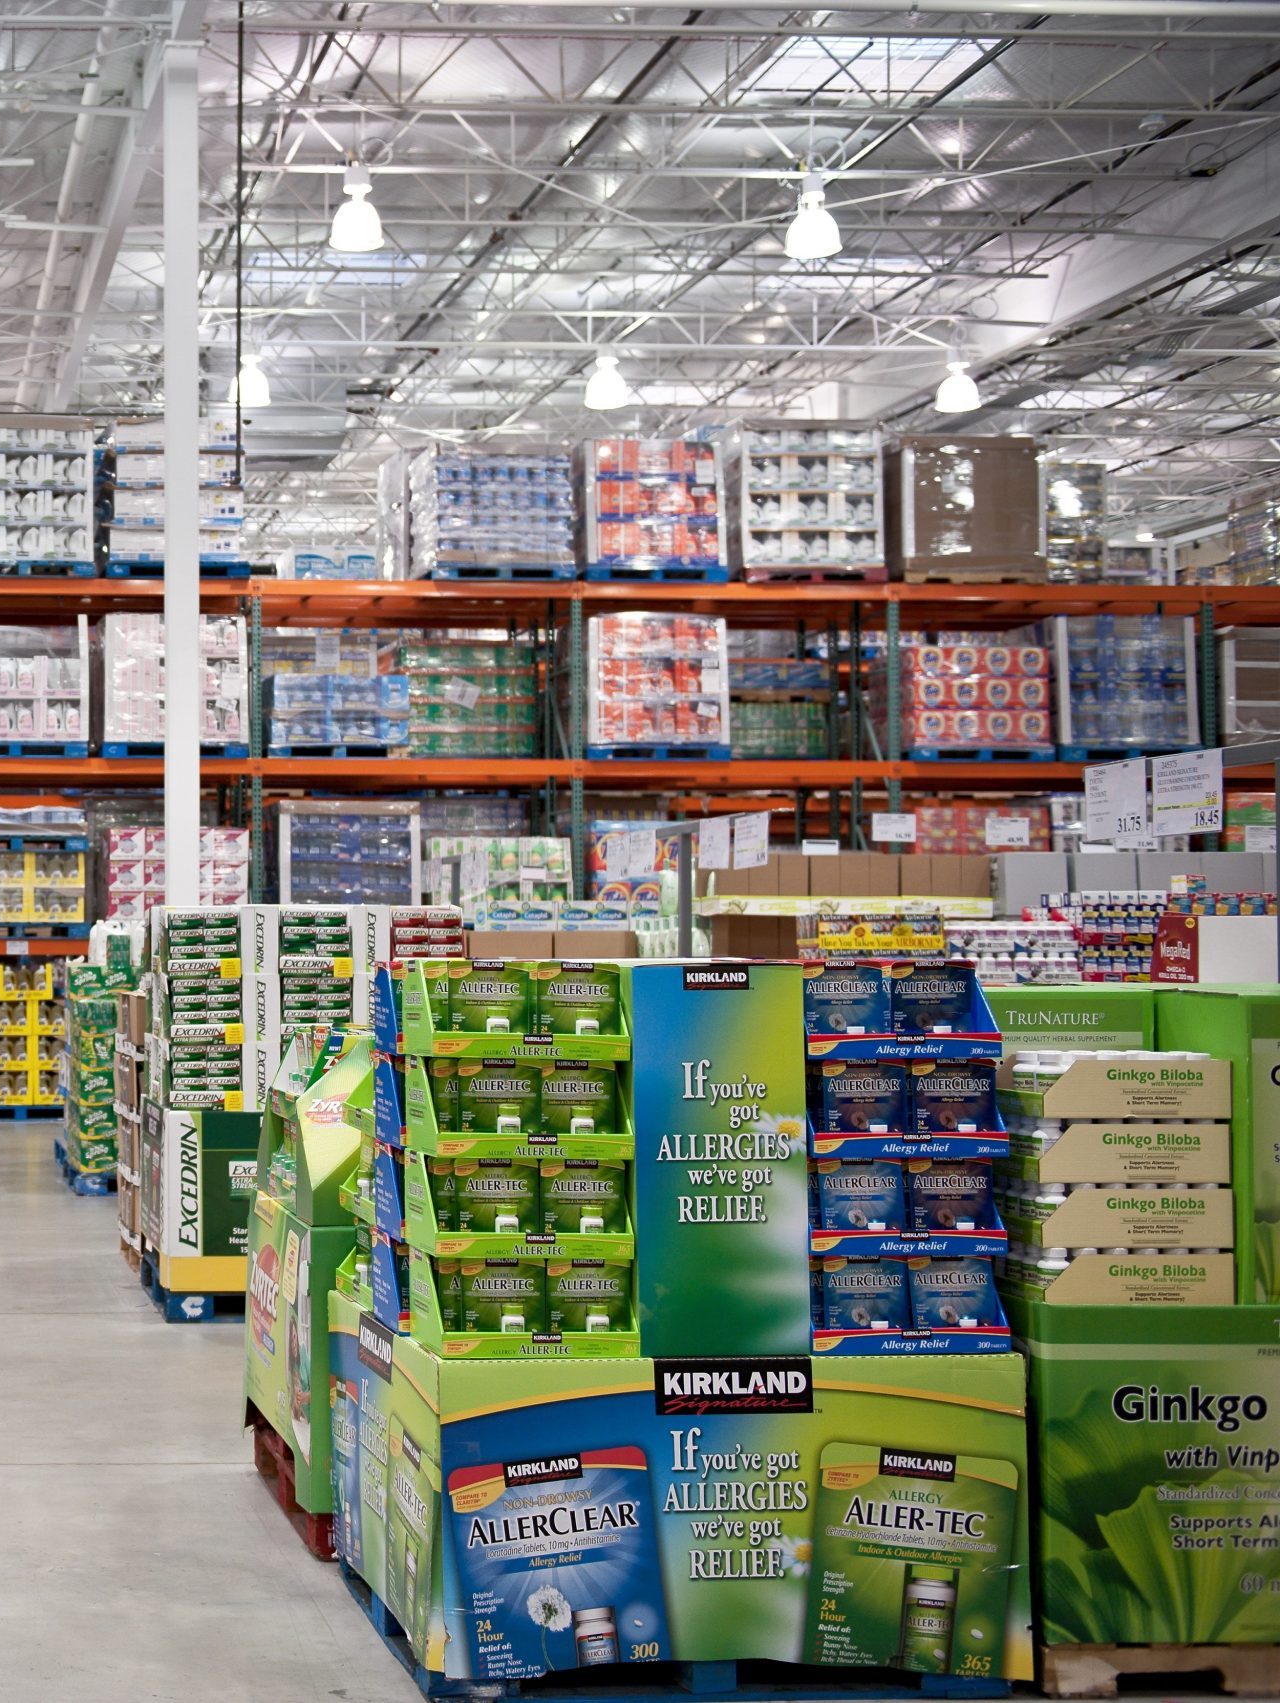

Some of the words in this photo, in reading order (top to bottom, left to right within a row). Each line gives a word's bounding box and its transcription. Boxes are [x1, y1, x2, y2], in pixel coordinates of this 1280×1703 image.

[1118, 816, 1141, 833] 31.75
[1195, 810, 1218, 826] 18.45
[492, 911, 517, 919] Cetaphil
[564, 911, 588, 919] Cetaphil
[256, 912, 264, 968] EXCEDRIN
[839, 937, 852, 947] You
[895, 936, 941, 948] AIRBORNE?
[1160, 942, 1190, 960] MegaRed
[171, 962, 219, 970] EXCEDRIN
[282, 959, 332, 968] EXCEDRIN
[686, 972, 746, 983] KIRKLAND
[459, 981, 519, 994] ALLER-TEC
[549, 982, 609, 996] ALLER-TEC
[807, 980, 877, 993] ALLERCLEAR
[895, 980, 966, 993] ALLERCLEAR
[257, 981, 266, 1036] EXCEDRIN
[510, 1045, 562, 1057] ALLER-TEC
[876, 1046, 911, 1056] Allergy
[914, 1045, 943, 1054] Relief
[682, 1060, 710, 1099] If
[710, 1074, 765, 1106] you've
[1106, 1069, 1155, 1084] Ginkgo
[1160, 1069, 1203, 1081] Biloba
[469, 1078, 530, 1092] ALLER-TEC
[828, 1078, 900, 1092] ALLERCLEAR
[730, 1103, 759, 1128] got
[657, 1133, 790, 1161] ALLERGIES
[1102, 1134, 1152, 1148] Ginkgo
[1157, 1134, 1201, 1145] Biloba
[178, 1122, 198, 1249] EXCEDRIN
[688, 1164, 737, 1185] we've
[742, 1166, 771, 1192] got
[552, 1181, 613, 1192] ALLER-TEC
[678, 1195, 767, 1223] RELIEF.
[1106, 1198, 1156, 1213] Ginkgo
[1161, 1198, 1205, 1209] Biloba
[914, 1273, 987, 1285] ALLERCLEAR
[1109, 1265, 1158, 1280] Ginkgo
[1163, 1265, 1206, 1276] Biloba
[249, 1250, 281, 1322] ZYRTEC
[359, 1324, 391, 1364] KIRKLAND
[519, 1344, 572, 1355] ALLER-TEC
[881, 1341, 917, 1351] Allergy
[920, 1340, 950, 1348] Relief
[664, 1371, 807, 1395] KIRKLAND
[664, 1395, 807, 1416] Signature
[1112, 1386, 1268, 1432] Ginkgo
[670, 1427, 701, 1471] If
[701, 1444, 761, 1478] you've
[767, 1450, 798, 1477] got
[1165, 1447, 1217, 1468] with
[507, 1458, 579, 1478] KIRKLAND
[884, 1454, 953, 1473] KIRKLAND
[393, 1465, 428, 1527] ALLER-TEC
[503, 1489, 592, 1511] NON-DROWSY
[663, 1481, 807, 1511] ALLERGIES
[889, 1489, 943, 1505] ALLERGY
[1157, 1485, 1239, 1500] Standardized
[468, 1502, 638, 1548] ALLERCLEAR
[844, 1497, 984, 1537] ALLER-TEC
[1170, 1516, 1252, 1532] Supports
[691, 1515, 744, 1538] we've
[749, 1517, 781, 1545] got
[1174, 1535, 1224, 1549] Short
[1230, 1536, 1278, 1549] Term
[529, 1556, 556, 1568] Allergy
[558, 1552, 582, 1563] Relief
[858, 1544, 884, 1555] Indoor
[886, 1547, 893, 1555] &
[895, 1547, 926, 1559] Outdoor
[928, 1550, 962, 1565] Allergies
[689, 1549, 784, 1579] RELIEF.
[1240, 1574, 1264, 1593] 60
[473, 1591, 494, 1601] Original
[473, 1597, 504, 1608] Prescription
[474, 1605, 496, 1615] Strength
[821, 1599, 836, 1611] 24
[820, 1610, 846, 1622] Hour
[476, 1620, 492, 1633] 24
[477, 1631, 504, 1643] Hour
[479, 1644, 501, 1653] Relief
[502, 1642, 512, 1650] of:
[630, 1642, 659, 1660] 300
[961, 1654, 992, 1671] 365
